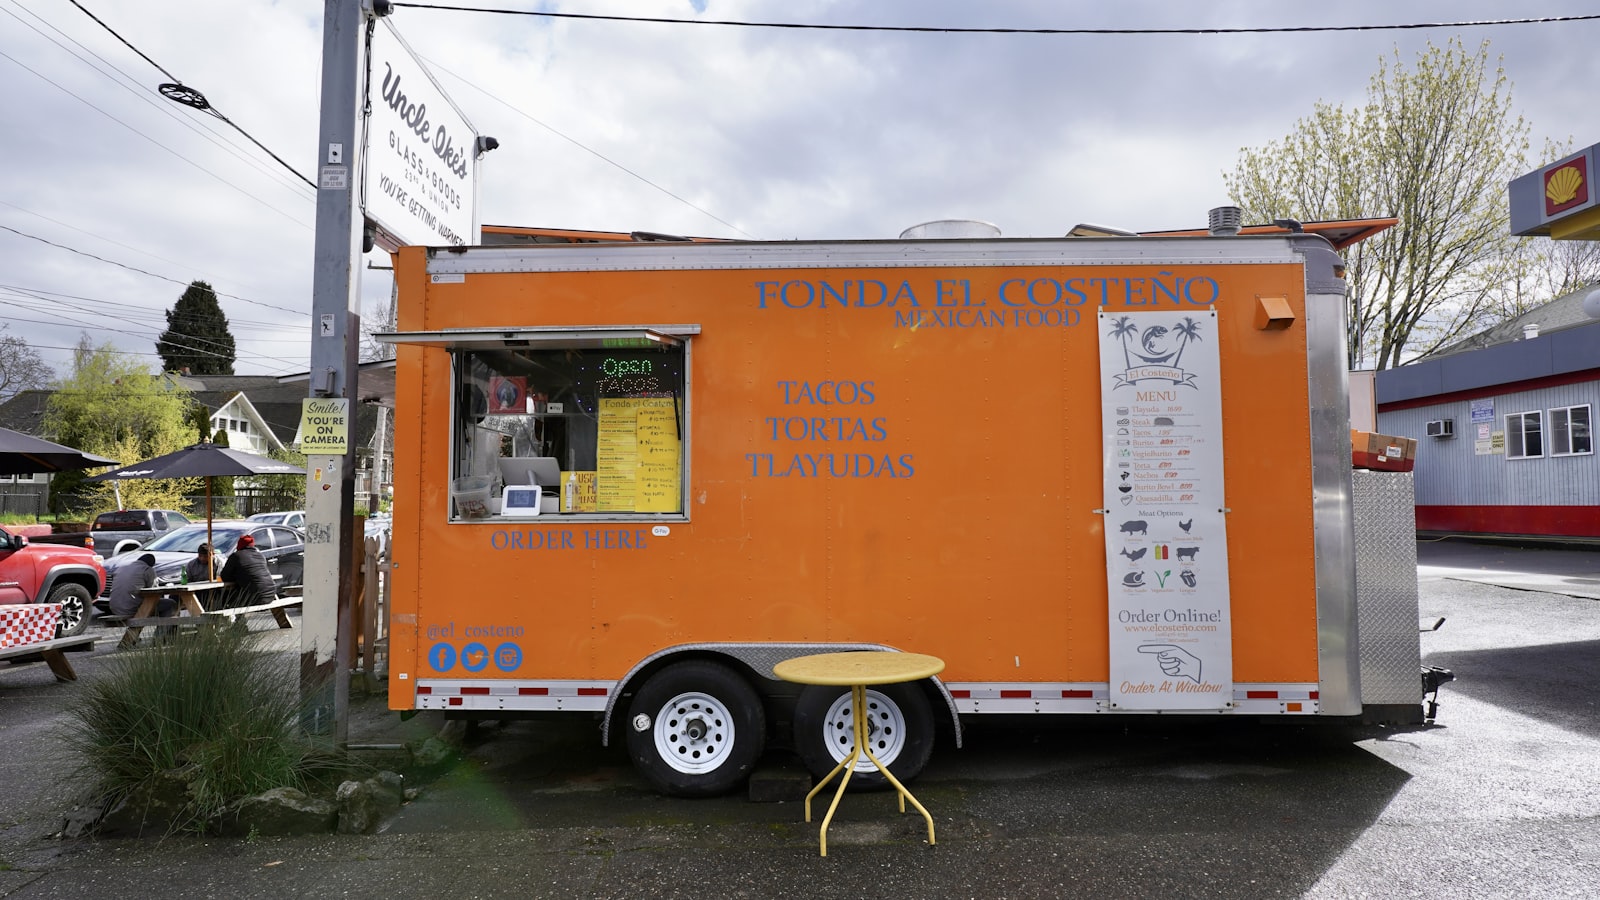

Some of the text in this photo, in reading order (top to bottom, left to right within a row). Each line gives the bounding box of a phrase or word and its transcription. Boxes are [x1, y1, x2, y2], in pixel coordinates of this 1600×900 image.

[381, 61, 467, 179] Uncle Ike's
[389, 130, 423, 175] GLASS
[432, 171, 460, 210] GOODS
[380, 172, 407, 207] YOU'RE
[409, 198, 436, 230] GETTING
[429, 190, 448, 214] UNION
[755, 271, 1219, 309] FONDA EL COSTEÑO
[894, 309, 1080, 328] MEXICAN FOOD
[603, 358, 652, 377] Open
[1129, 368, 1180, 379] El Costeño
[596, 376, 659, 393] TACOS
[777, 381, 875, 405] TACOS
[605, 400, 630, 408] Fonda
[1136, 391, 1177, 402] MENU
[307, 402, 345, 414] Smile!
[1131, 406, 1159, 415] Tlayuda
[307, 417, 344, 425] YOU'RE
[766, 417, 887, 441] TORTAS
[304, 436, 345, 444] CAMERA
[745, 454, 914, 478] TLAYUDAS
[491, 530, 648, 550] ORDER HERE
[1119, 609, 1221, 623] Order Online!
[427, 622, 525, 640] @el_costeno
[1125, 624, 1217, 632] www.elcosteño.com
[1120, 680, 1223, 694] Order At Window
